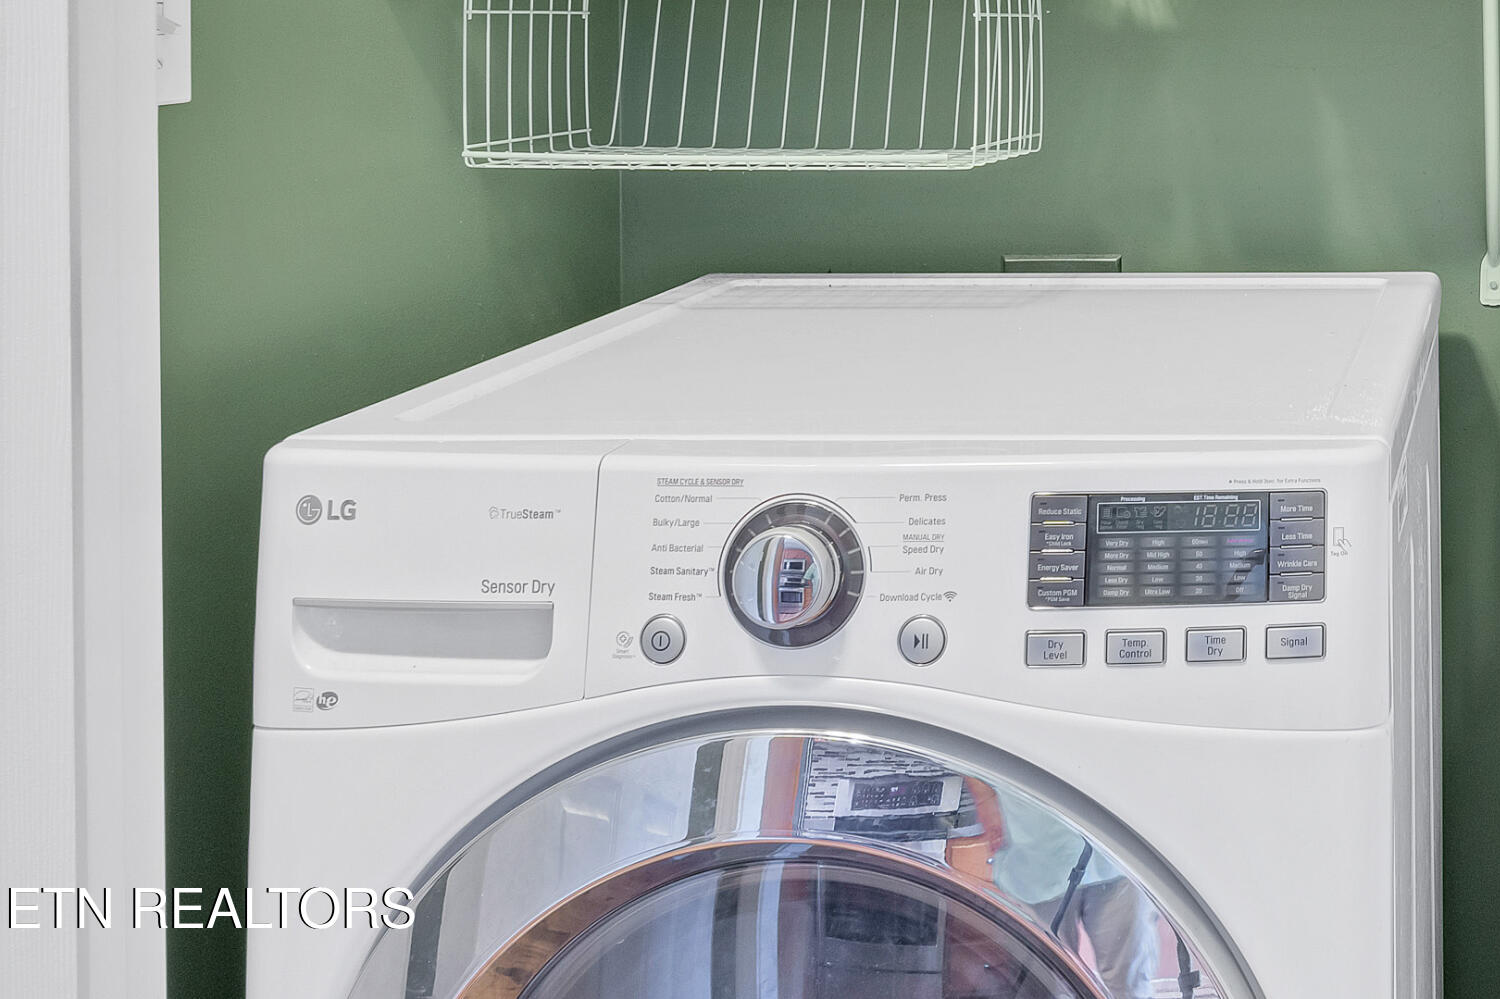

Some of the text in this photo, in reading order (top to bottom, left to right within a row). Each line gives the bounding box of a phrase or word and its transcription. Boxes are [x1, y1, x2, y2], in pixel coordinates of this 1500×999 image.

[656, 478, 679, 486] STEAM
[680, 478, 700, 486] CYCLE
[654, 494, 713, 503] Cotton/Normal
[899, 493, 948, 502] Perm. Press
[327, 499, 356, 520] LG
[652, 518, 700, 528] Bulky/Large
[908, 517, 946, 526] Delicates
[651, 544, 704, 552] Anti Bacterial
[902, 544, 944, 555] Speed Dry
[1234, 550, 1246, 558] High
[1038, 564, 1060, 572] Energy
[1277, 560, 1302, 568] Wrinkle
[650, 566, 675, 576] Steam
[914, 566, 944, 576] Air Dry
[481, 579, 556, 597] Sensor Dry
[1282, 584, 1312, 592] Damp Dry
[648, 592, 674, 601] Steam
[879, 592, 943, 602] Download Cycle
[1119, 590, 1130, 598] Dry
[1288, 592, 1308, 600] Signal
[1047, 639, 1064, 652] Dry
[1122, 638, 1148, 651] Temp.
[1204, 636, 1226, 646] Time
[1280, 636, 1308, 649] Signal
[1043, 649, 1068, 660] Level
[1118, 648, 1152, 659] Control
[1207, 646, 1224, 658] Dry
